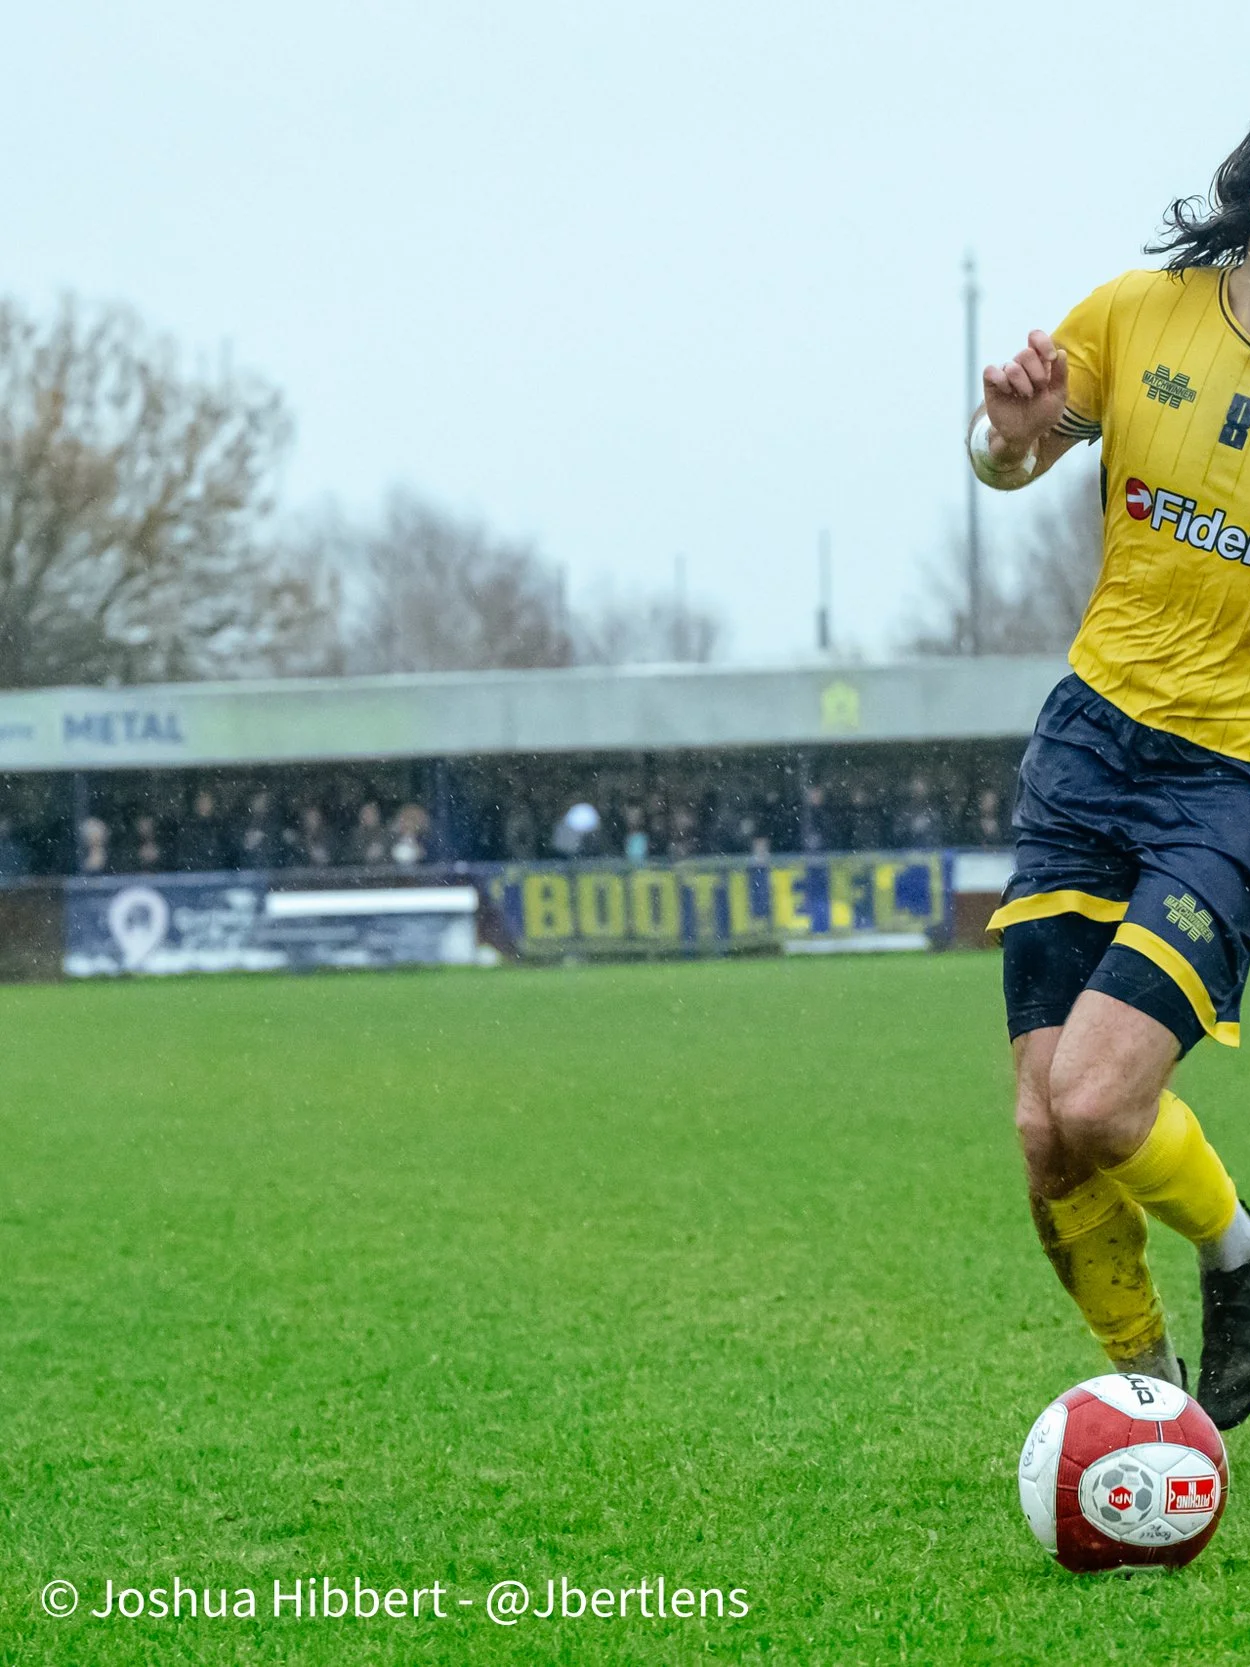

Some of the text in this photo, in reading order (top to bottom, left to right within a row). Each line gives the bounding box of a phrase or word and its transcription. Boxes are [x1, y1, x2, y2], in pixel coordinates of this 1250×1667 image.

[1143, 370, 1196, 402] MATCHWINNER
[522, 866, 812, 940] BOOTLE
[1164, 894, 1214, 943] MATCHWINNER
[1176, 1493, 1211, 1509] PITCHING
[1187, 1481, 1197, 1496] IN
